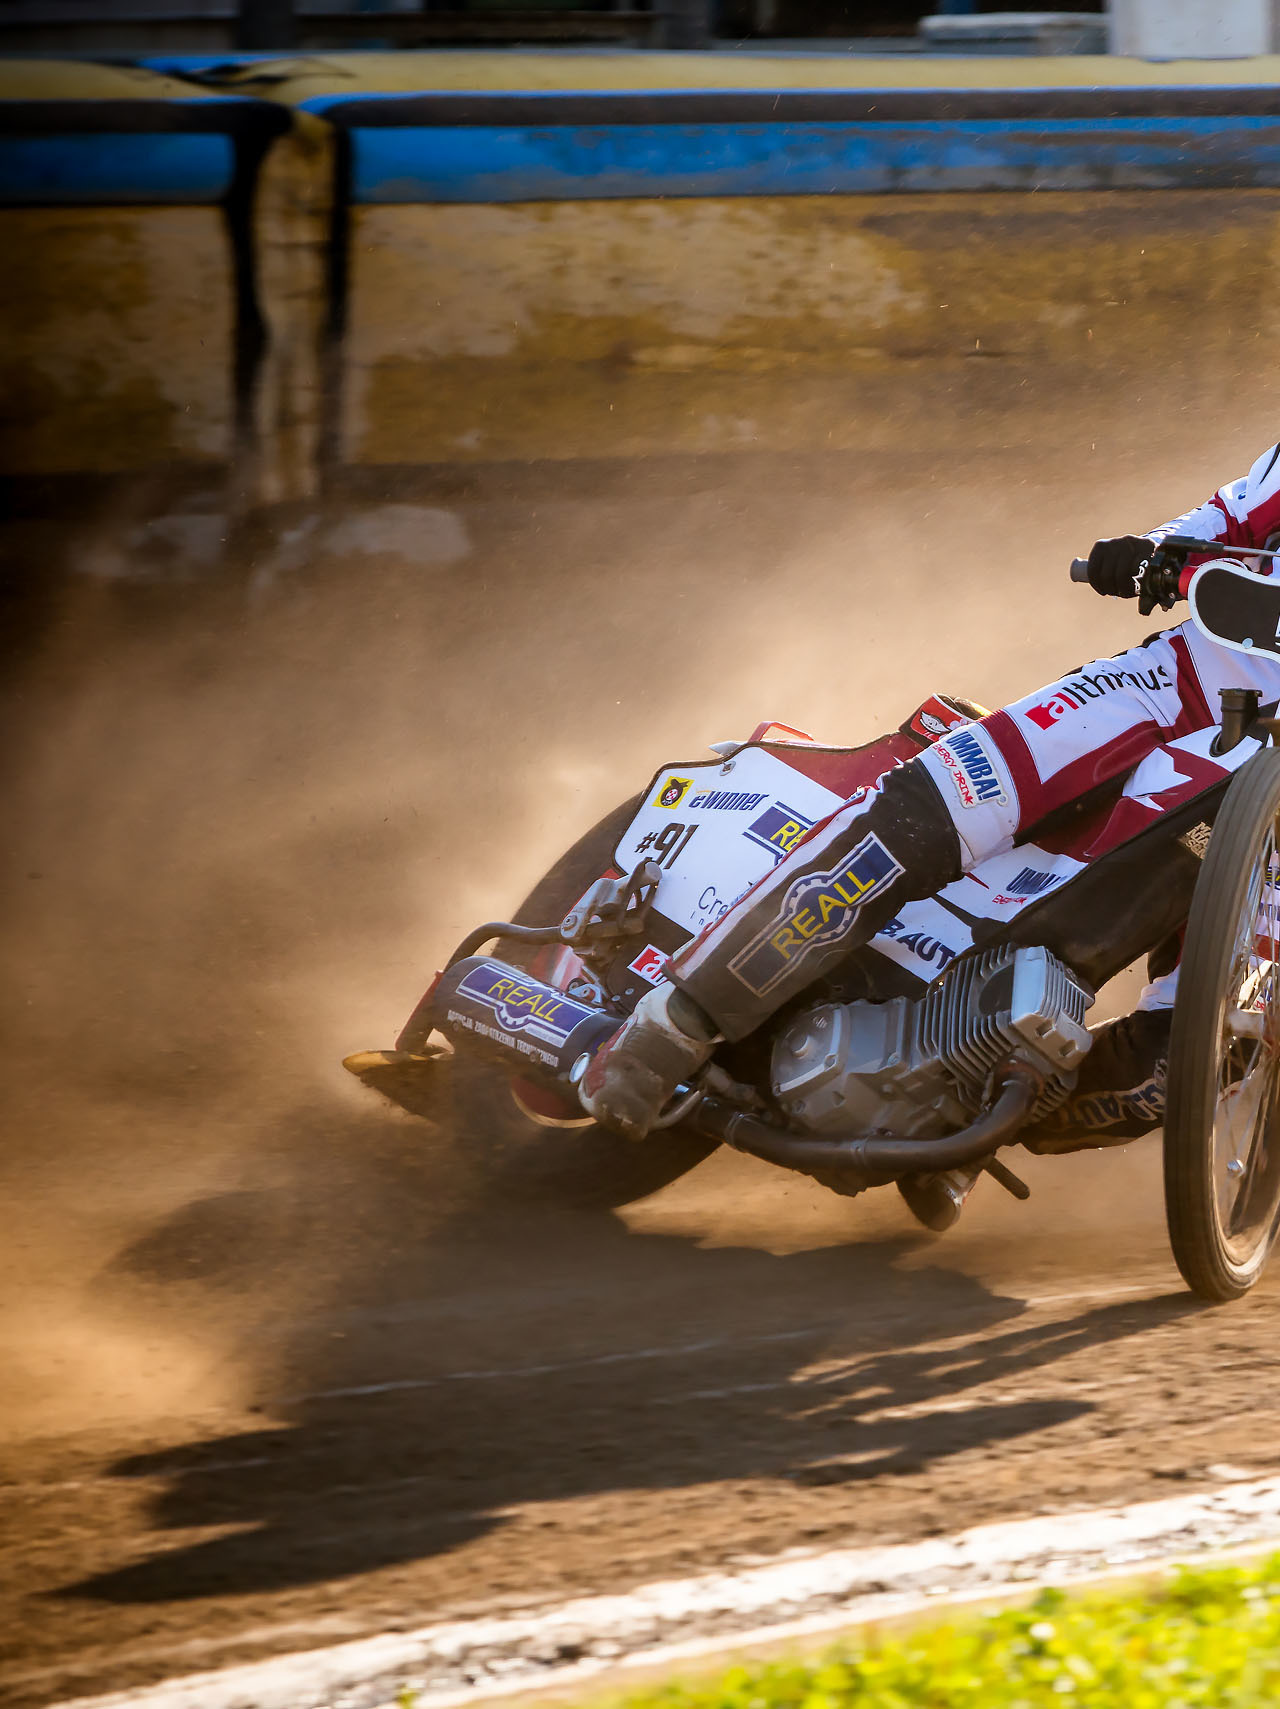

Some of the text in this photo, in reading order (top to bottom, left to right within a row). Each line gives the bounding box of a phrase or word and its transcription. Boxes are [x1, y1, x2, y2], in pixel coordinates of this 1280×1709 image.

[688, 790, 770, 811] eWinner
[953, 769, 974, 805] DRINK
[770, 869, 876, 960] REALL
[487, 977, 564, 1023] REALL
